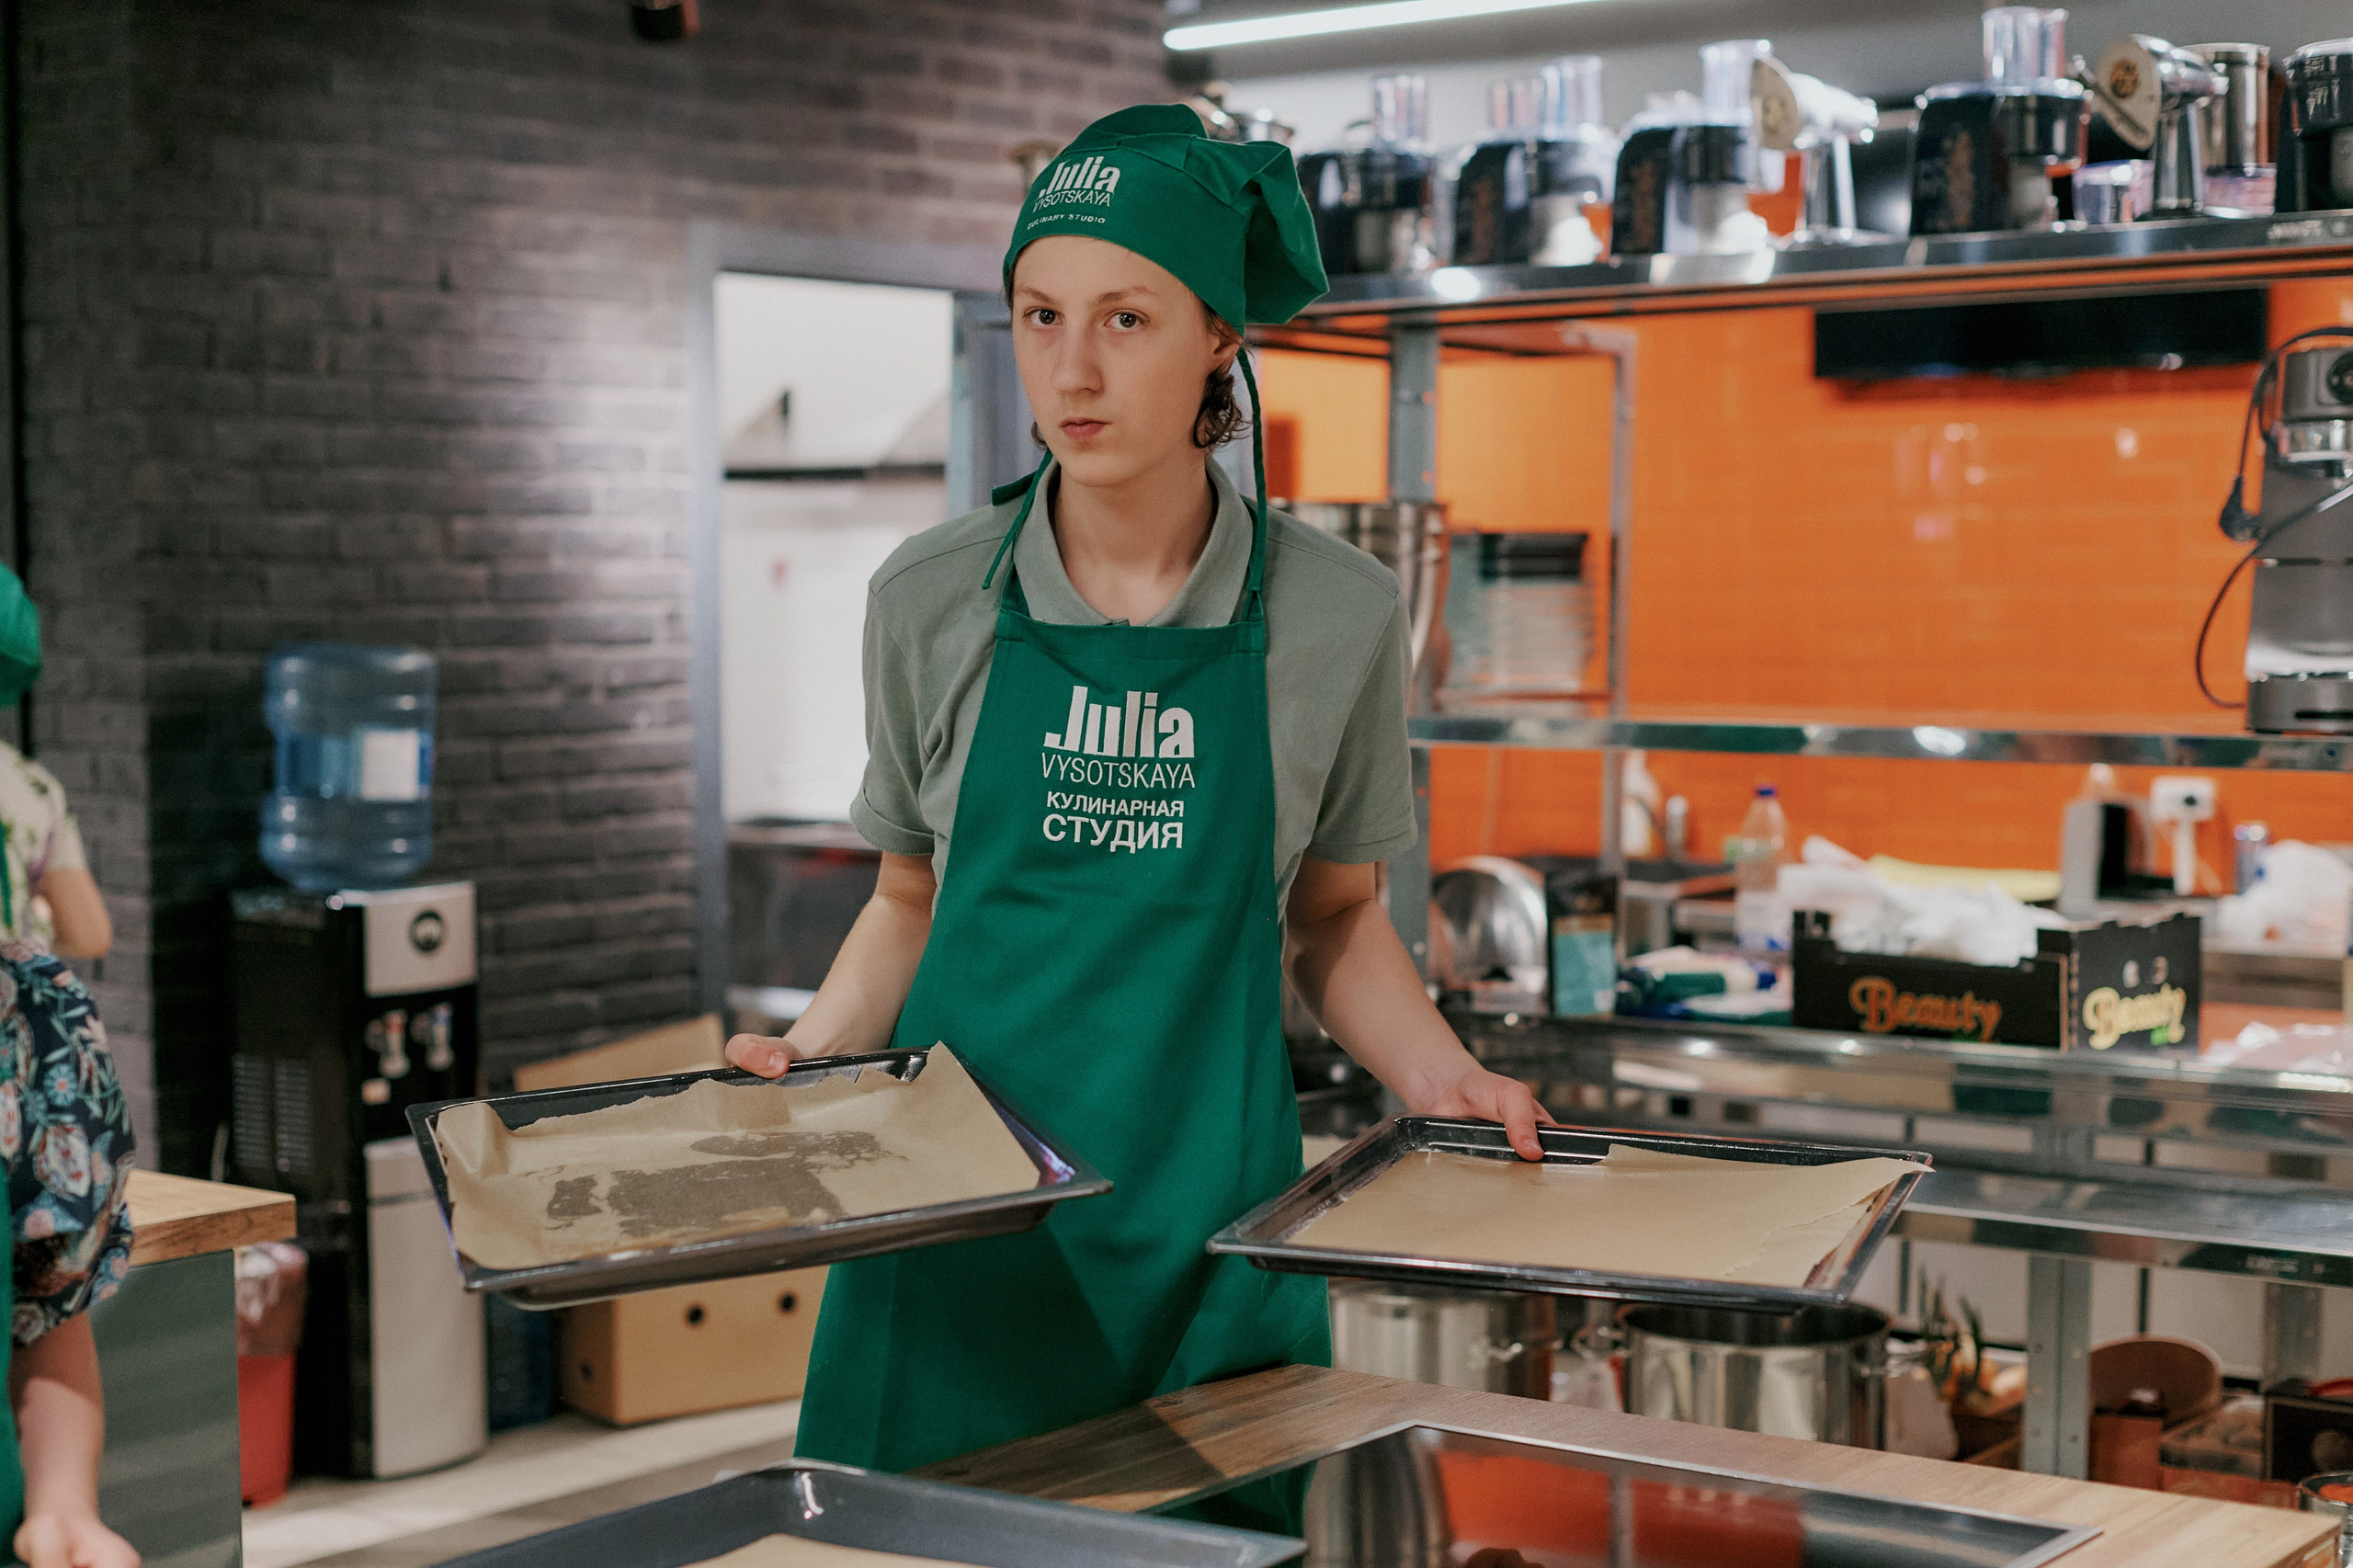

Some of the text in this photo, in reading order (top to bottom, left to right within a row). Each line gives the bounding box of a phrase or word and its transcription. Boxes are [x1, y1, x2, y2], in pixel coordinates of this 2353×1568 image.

[1038, 156, 1120, 197] Julia
[1032, 189, 1110, 212] VYSOTSKAYA
[1068, 214, 1106, 223] STUDIO
[1043, 686, 1195, 758] Julia
[1041, 752, 1196, 789] VYSOTSKAYA
[1046, 790, 1184, 817] КУЛИНАРНАЯ
[1042, 813, 1183, 854] СТУДИЯ
[1849, 977, 2002, 1043] Beauty
